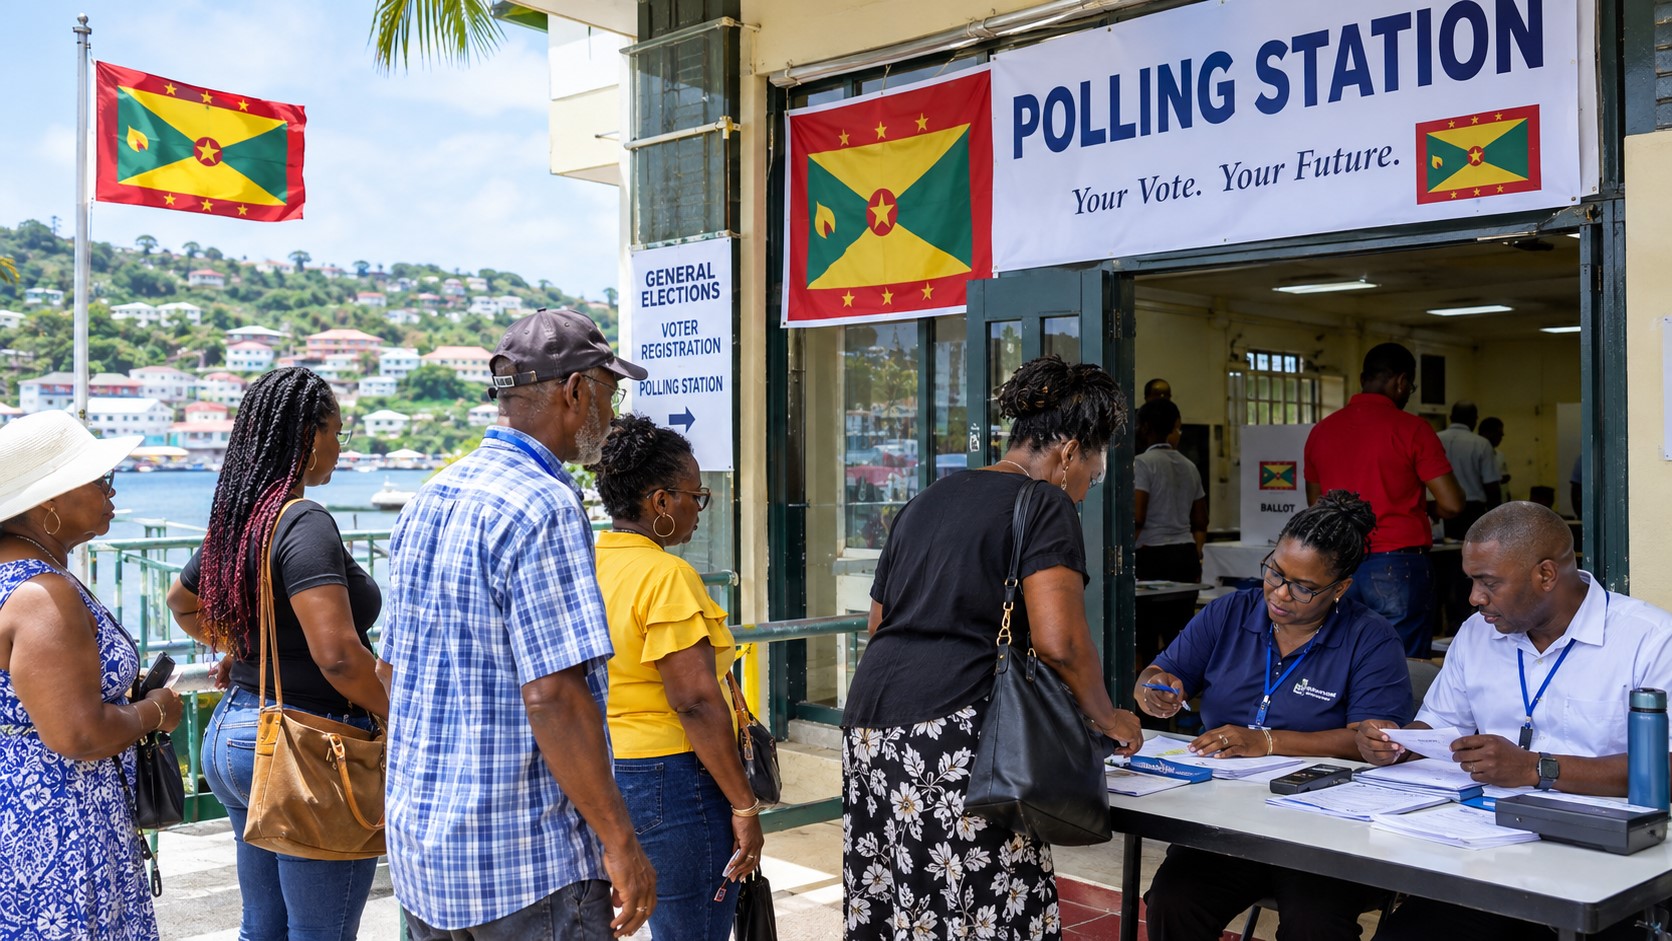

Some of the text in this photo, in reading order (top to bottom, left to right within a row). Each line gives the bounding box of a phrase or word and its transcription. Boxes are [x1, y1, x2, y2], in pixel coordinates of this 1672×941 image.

[1013, 0, 1544, 160] POLLING STATION
[1071, 145, 1400, 215] Your Vote. Your Future.
[645, 262, 716, 288] GENERAL
[641, 281, 720, 308] ELECTIONS
[661, 319, 698, 338] VOTER
[641, 337, 721, 360] REGISTRATION
[639, 375, 723, 396] POLLING STATION
[1260, 503, 1296, 513] BALLOT
